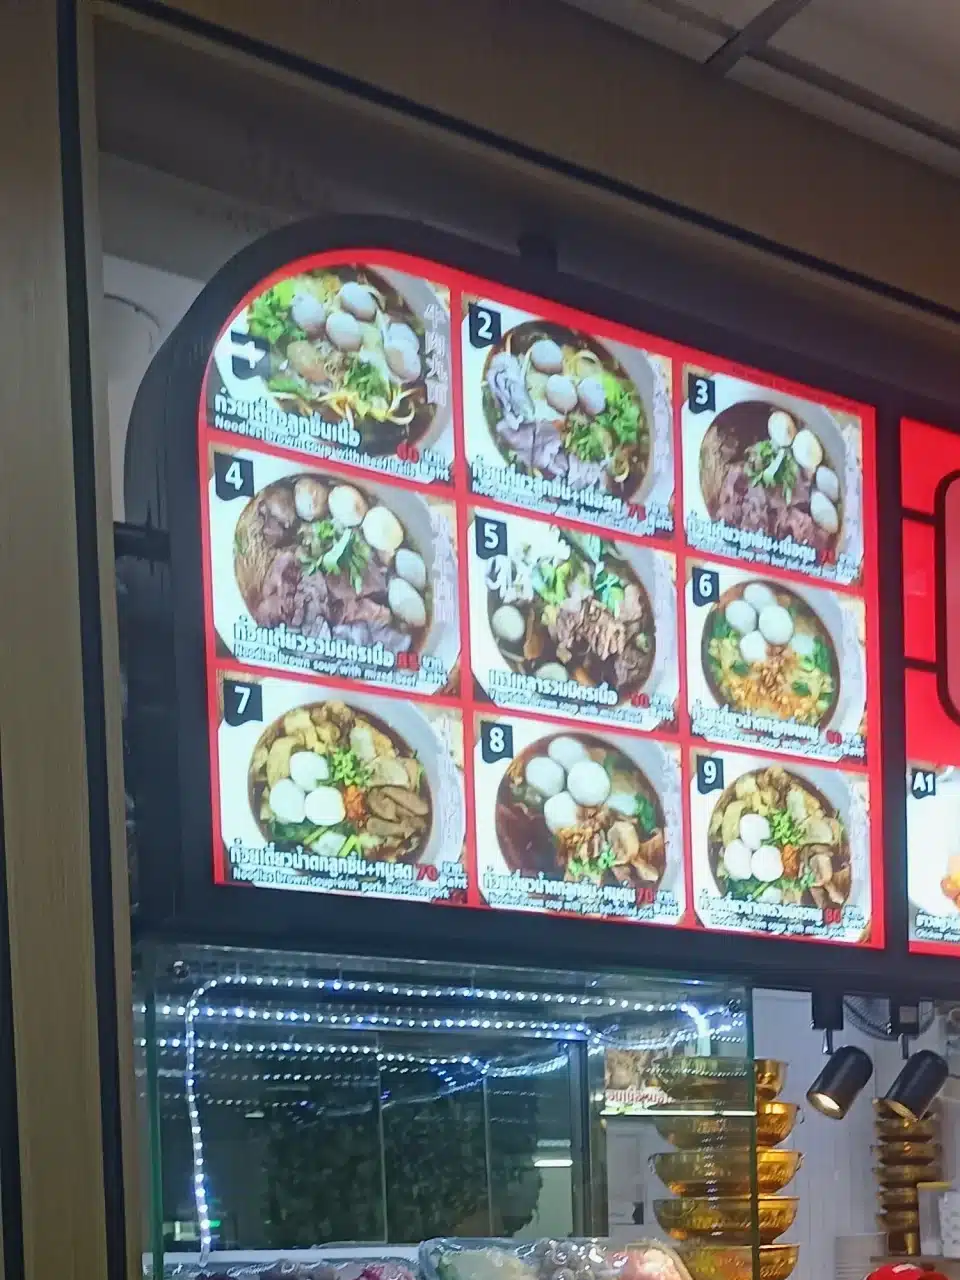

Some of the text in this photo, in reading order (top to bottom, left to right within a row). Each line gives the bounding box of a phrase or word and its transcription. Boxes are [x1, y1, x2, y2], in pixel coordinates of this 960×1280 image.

[477, 312, 492, 340] 2
[696, 380, 709, 406] 3
[225, 461, 244, 491] 4
[484, 523, 498, 549] 5
[699, 574, 712, 598] 6
[234, 686, 250, 715] 7
[490, 730, 504, 752] 8
[703, 761, 717, 784] 9
[913, 772, 934, 793] A1
